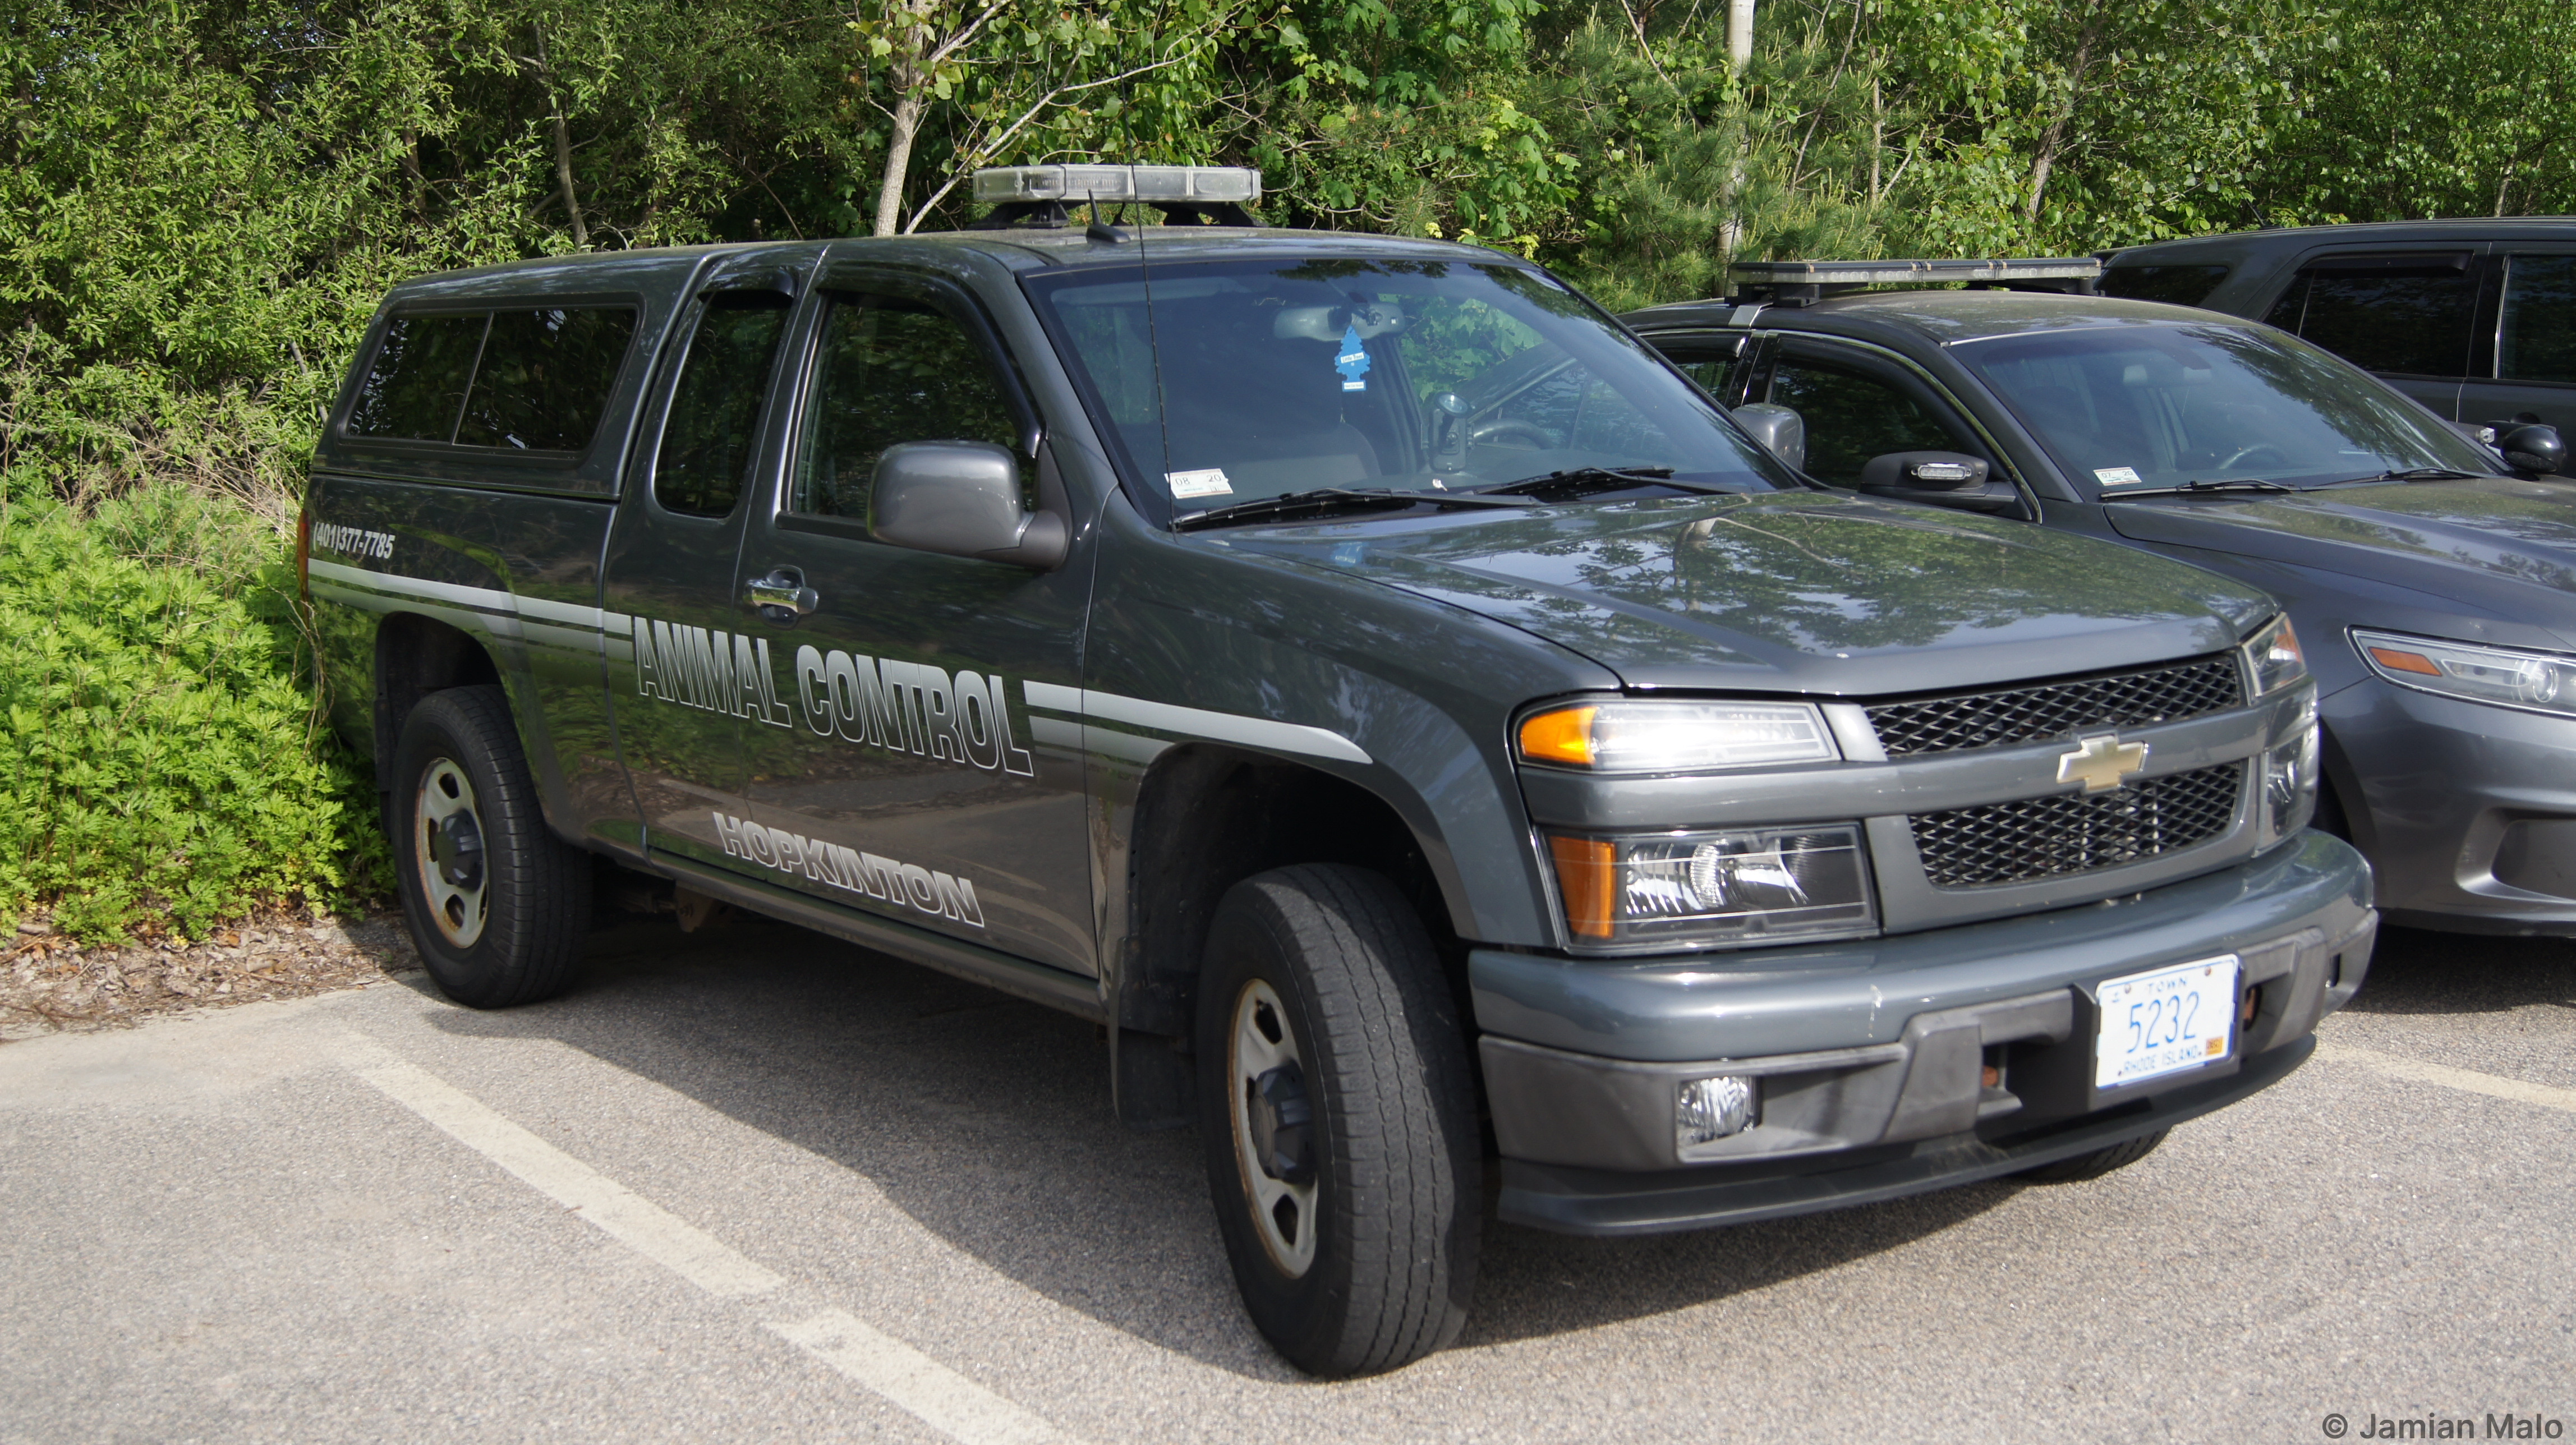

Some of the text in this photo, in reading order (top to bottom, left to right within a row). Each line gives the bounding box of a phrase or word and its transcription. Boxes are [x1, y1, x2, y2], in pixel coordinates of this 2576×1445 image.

[1175, 474, 1222, 486] 08 20
[312, 521, 396, 559] (401)377-7785
[634, 616, 1034, 777] ANIMAL CONTROL
[713, 811, 986, 928] HOPKINTON
[2147, 975, 2188, 994] TOWN
[2126, 991, 2200, 1053] 5232
[2123, 1045, 2199, 1073] RHODE ISLAND
